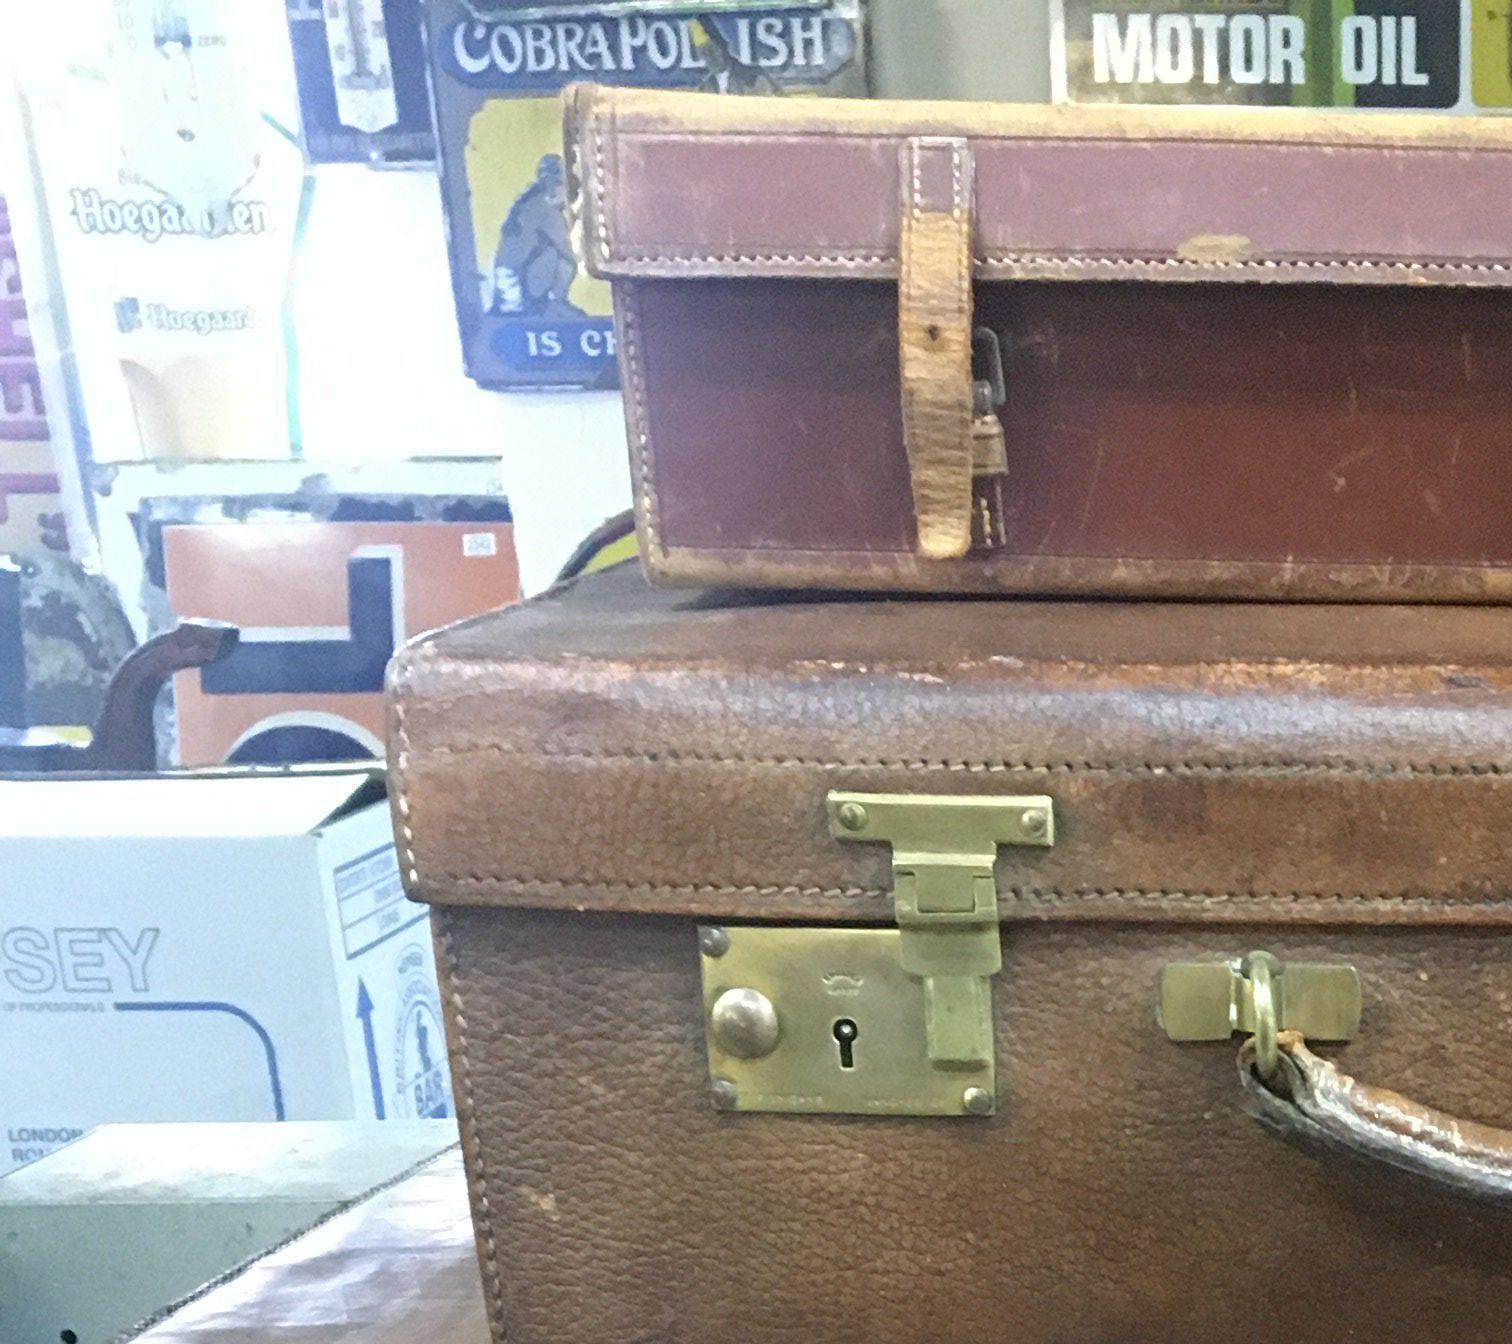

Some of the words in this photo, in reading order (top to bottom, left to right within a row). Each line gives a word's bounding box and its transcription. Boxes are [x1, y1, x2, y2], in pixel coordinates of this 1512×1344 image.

[453, 21, 617, 74] COBRA
[1092, 13, 1306, 85] MOTOR
[1341, 15, 1430, 85] OIL
[526, 330, 562, 357] IS
[1, 925, 161, 994] SEY
